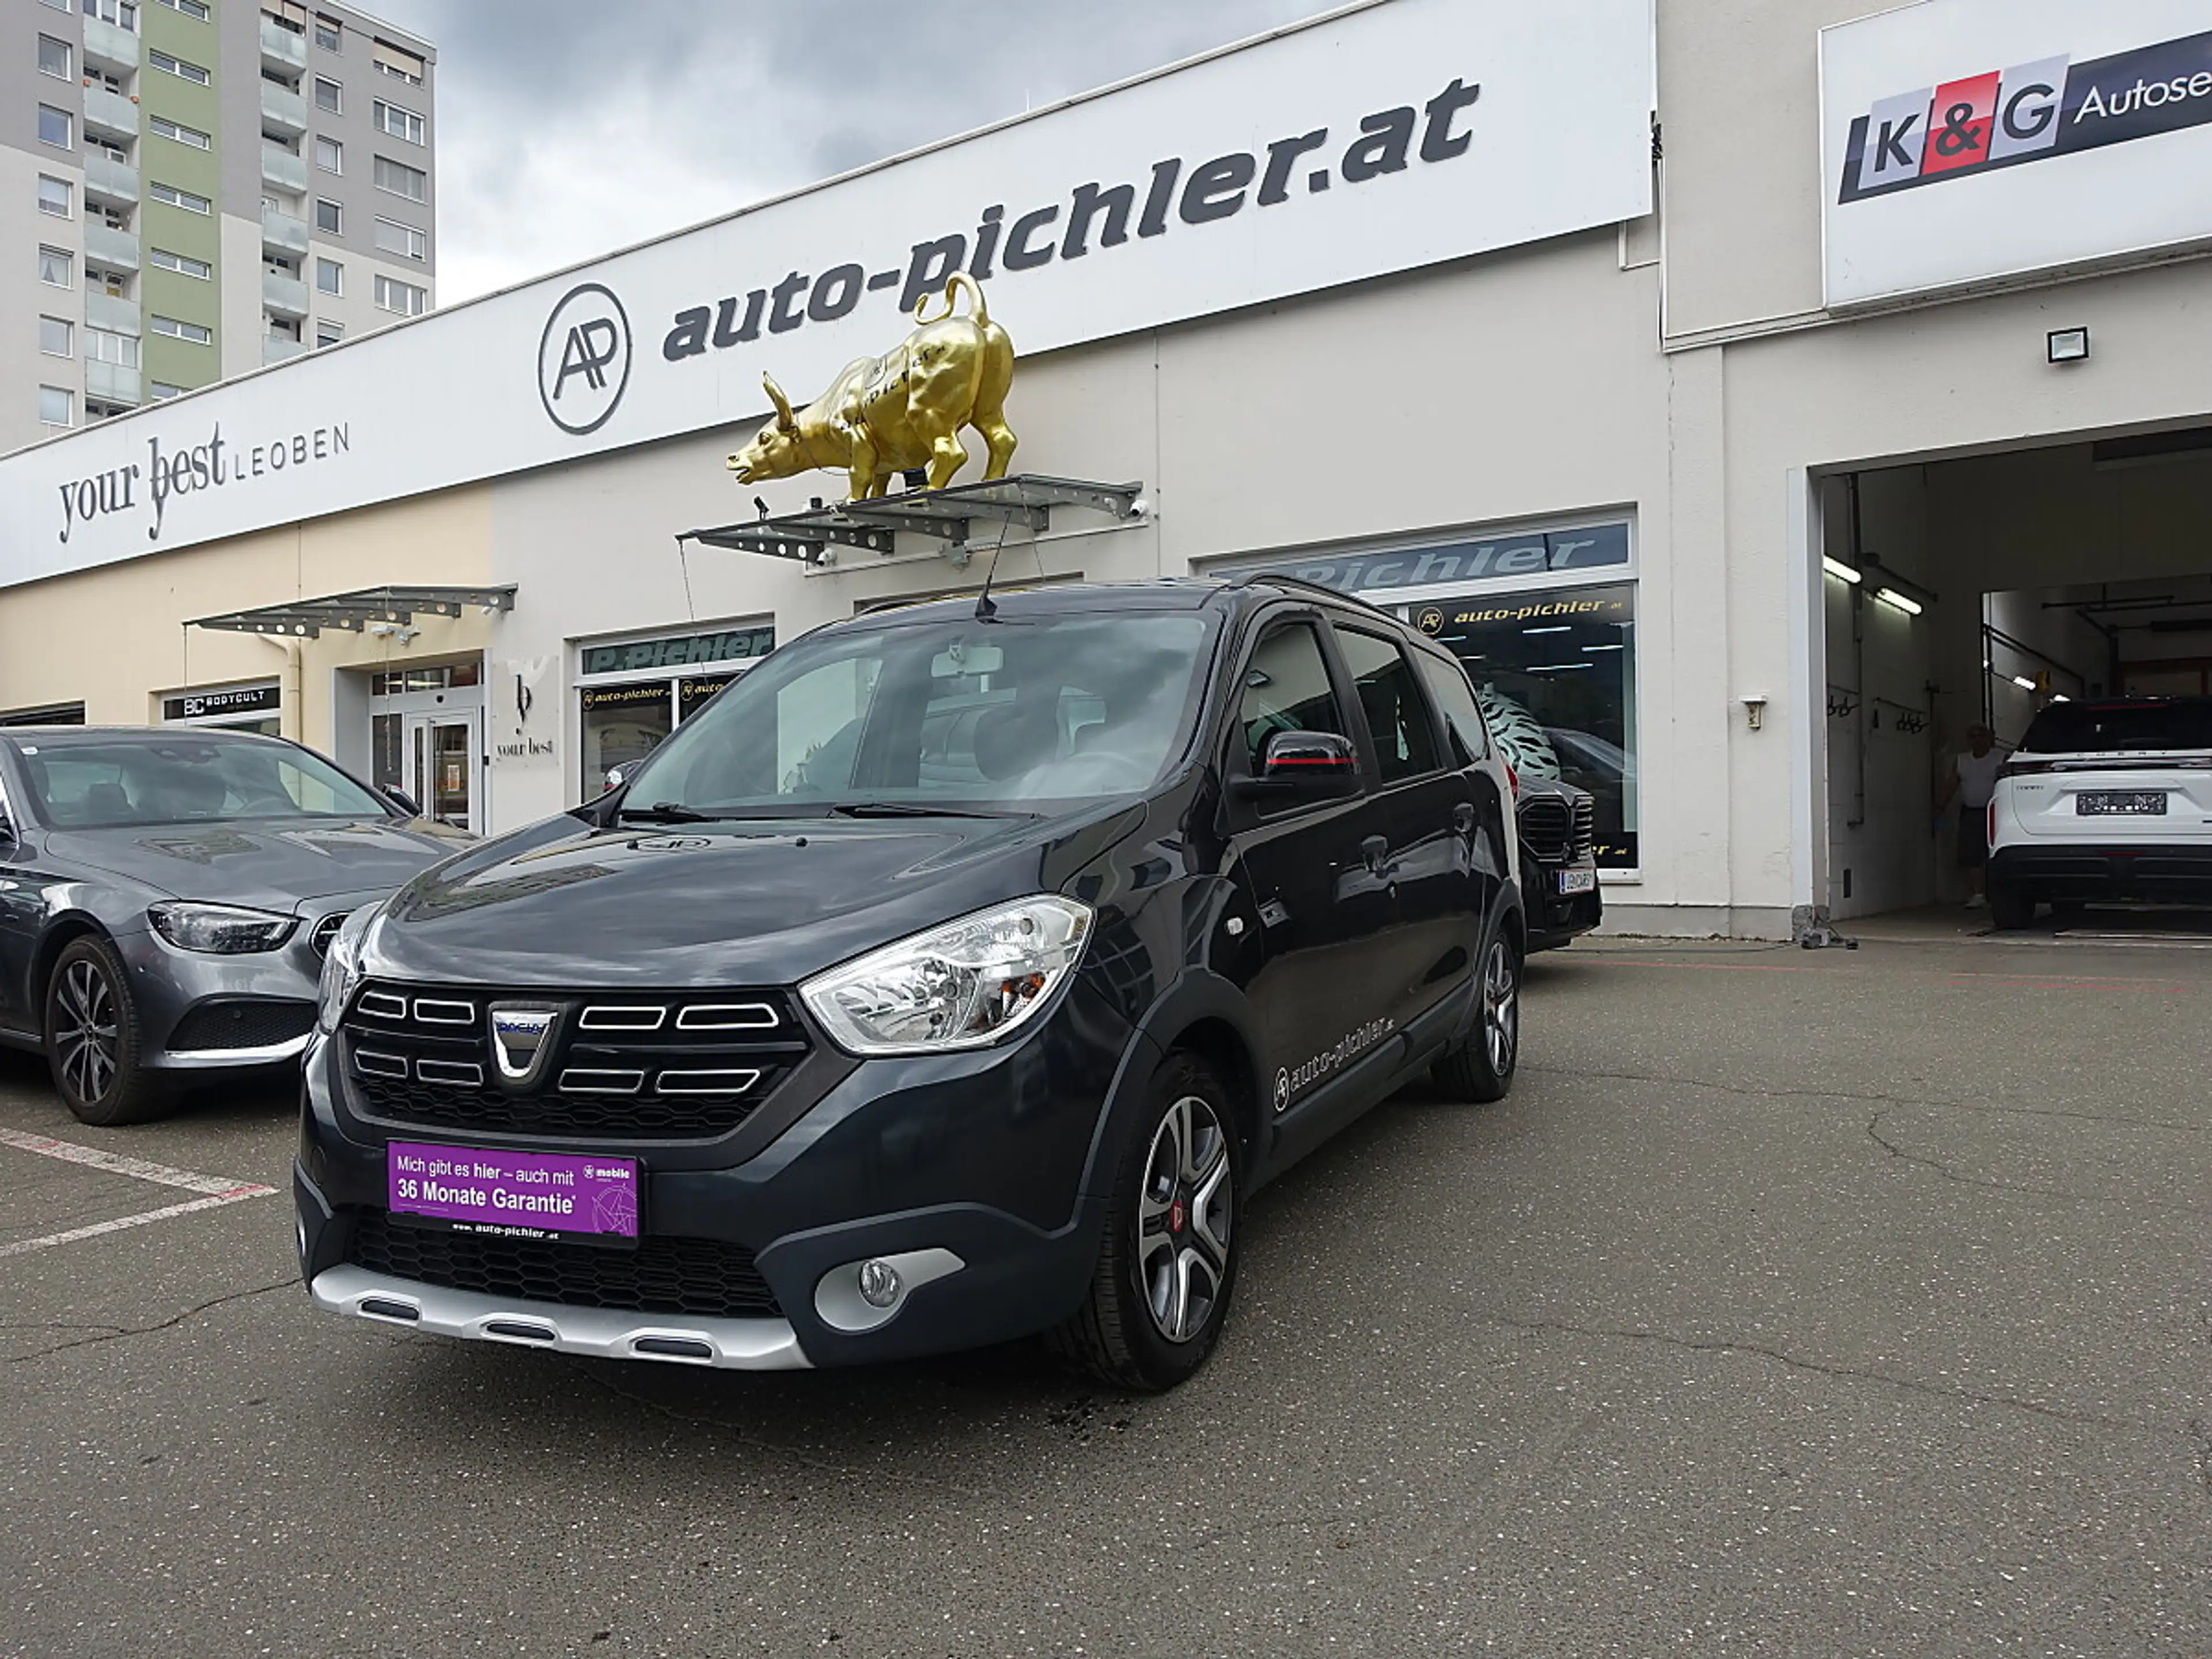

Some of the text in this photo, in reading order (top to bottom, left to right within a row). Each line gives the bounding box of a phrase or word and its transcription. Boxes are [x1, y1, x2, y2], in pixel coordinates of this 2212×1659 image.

[663, 77, 1480, 362] auto-pichler.at
[59, 421, 350, 543] your best LEOBEN
[1455, 600, 1605, 623] auto-pichler
[206, 691, 264, 706] BODYCULT
[595, 688, 664, 702] auto-pichler
[496, 737, 553, 761] your best
[397, 1156, 425, 1173] Mich
[429, 1159, 452, 1177] gibt
[454, 1164, 469, 1177] es
[473, 1162, 501, 1179] hier
[516, 1168, 548, 1184] auch
[552, 1170, 574, 1186] mit
[596, 1166, 630, 1179] mobile
[397, 1177, 417, 1199] 36
[423, 1181, 486, 1207] Monate
[475, 1224, 545, 1238] auto-pichler
